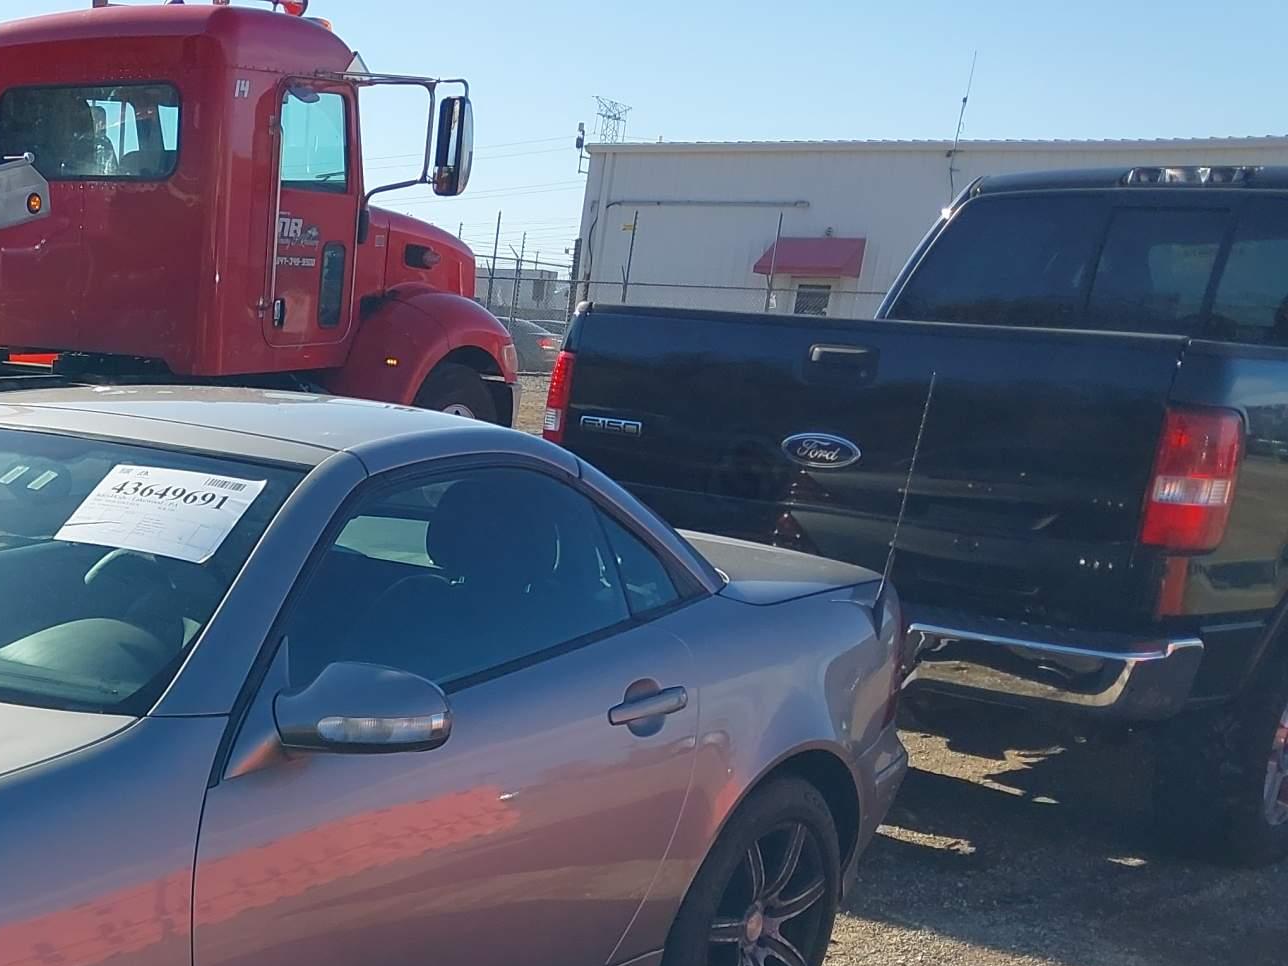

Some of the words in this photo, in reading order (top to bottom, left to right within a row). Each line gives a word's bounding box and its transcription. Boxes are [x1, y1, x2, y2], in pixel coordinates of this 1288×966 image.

[234, 79, 250, 98] 14
[796, 439, 841, 461] Ford
[111, 480, 230, 510] 43649691
